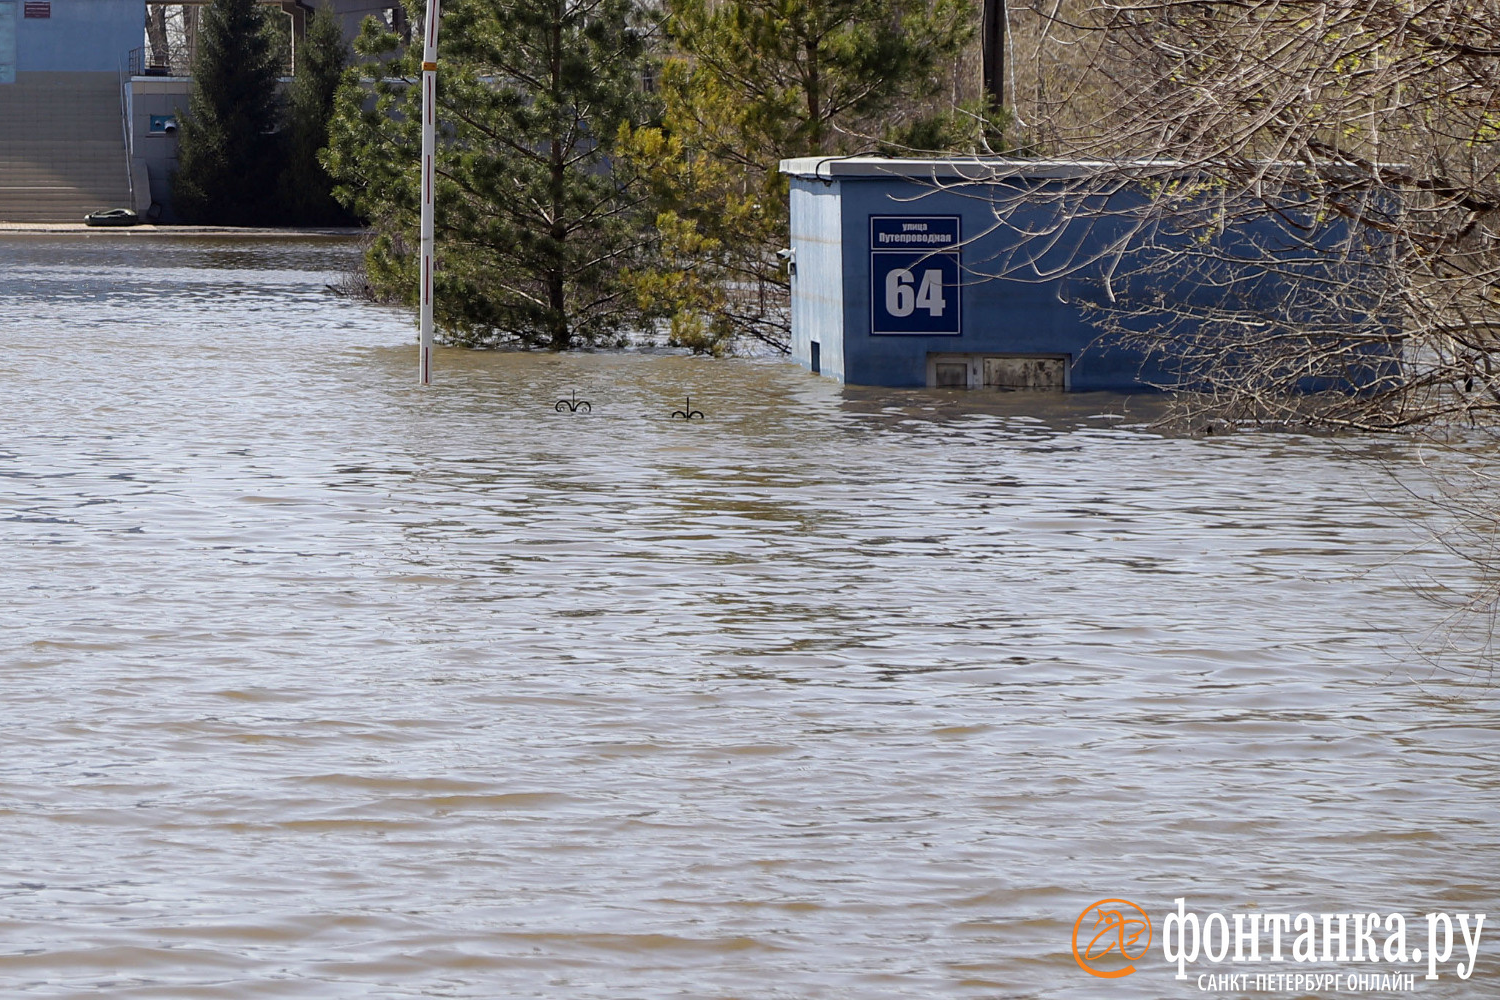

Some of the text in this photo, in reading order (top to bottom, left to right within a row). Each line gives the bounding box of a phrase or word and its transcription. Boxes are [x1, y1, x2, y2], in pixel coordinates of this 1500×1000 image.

[902, 223, 928, 232] улица
[879, 233, 952, 243] Путепроводная
[885, 268, 946, 317] 64
